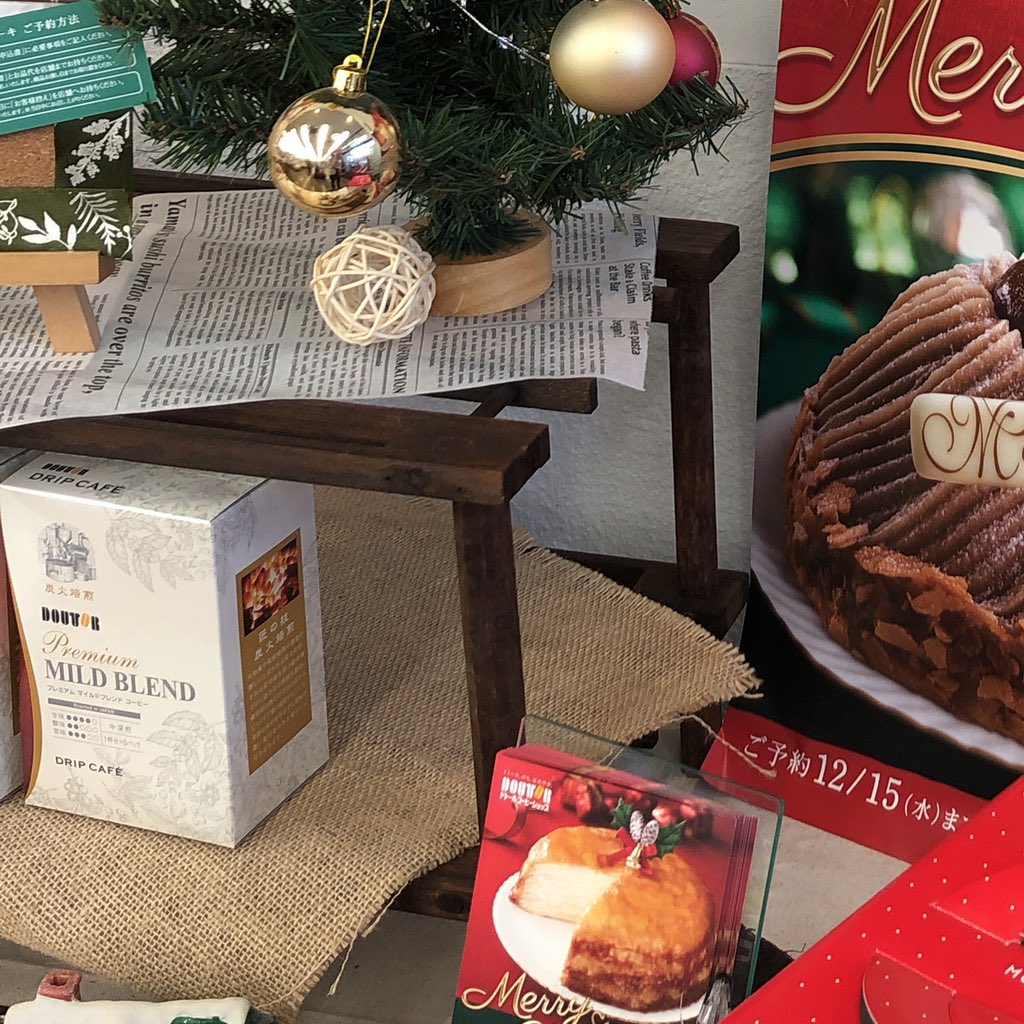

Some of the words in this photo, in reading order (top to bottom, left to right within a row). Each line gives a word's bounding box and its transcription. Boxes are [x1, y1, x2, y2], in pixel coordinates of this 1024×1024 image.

[23, 14, 80, 34] ご予約方法
[138, 204, 158, 217] in
[145, 237, 170, 262] sushi
[126, 263, 160, 302] burritos
[117, 304, 137, 324] are
[107, 326, 129, 356] over
[628, 336, 642, 355] pasta
[99, 358, 125, 374] the
[81, 375, 113, 395] top,
[28, 472, 75, 485] DRIP
[75, 479, 126, 495] CAFÉ
[41, 606, 100, 631] DOUTOR
[42, 630, 140, 669] Premium
[44, 658, 107, 688] MILD
[112, 671, 196, 702] BLEND
[55, 756, 86, 769] DRIP
[88, 761, 124, 777] CAFÉ
[461, 971, 593, 1024] Merry
